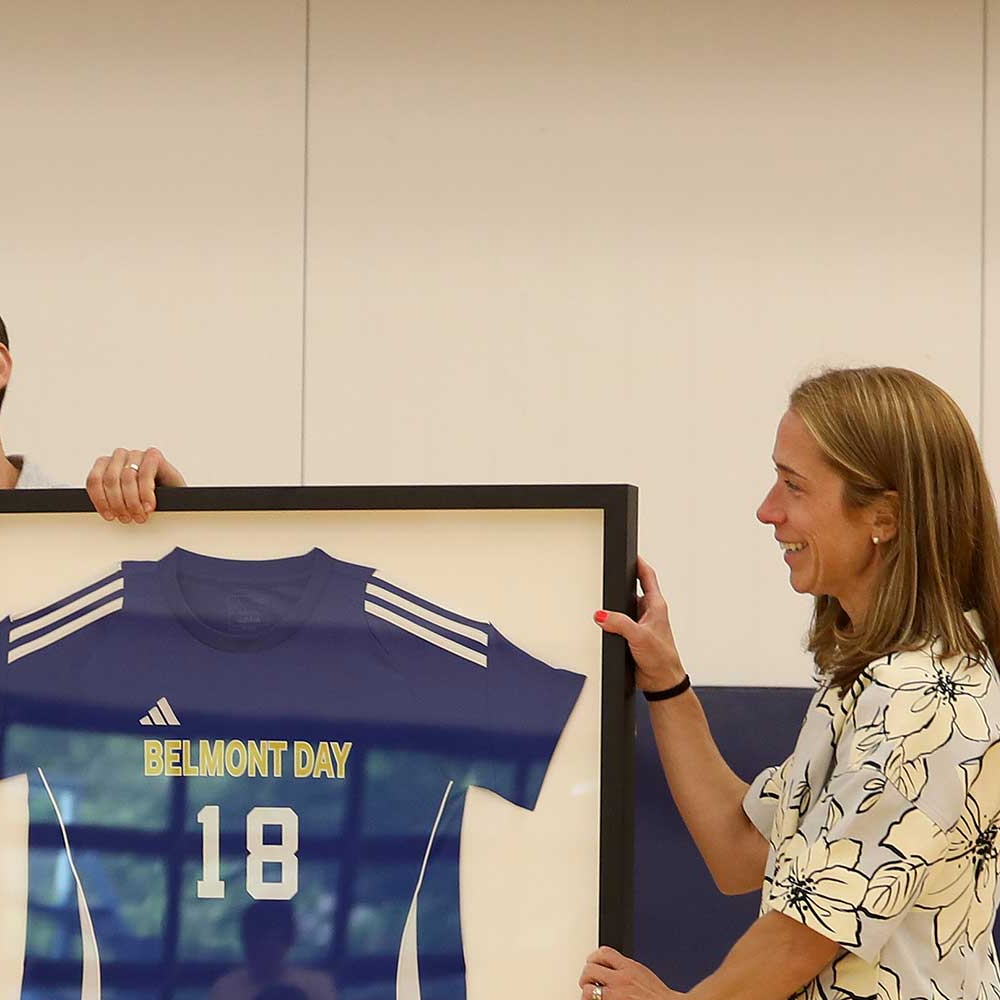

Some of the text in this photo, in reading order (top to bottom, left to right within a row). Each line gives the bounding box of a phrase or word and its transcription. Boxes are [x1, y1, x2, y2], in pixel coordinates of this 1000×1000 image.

[143, 739, 353, 779] BELMONT DAY
[196, 805, 299, 900] 18
